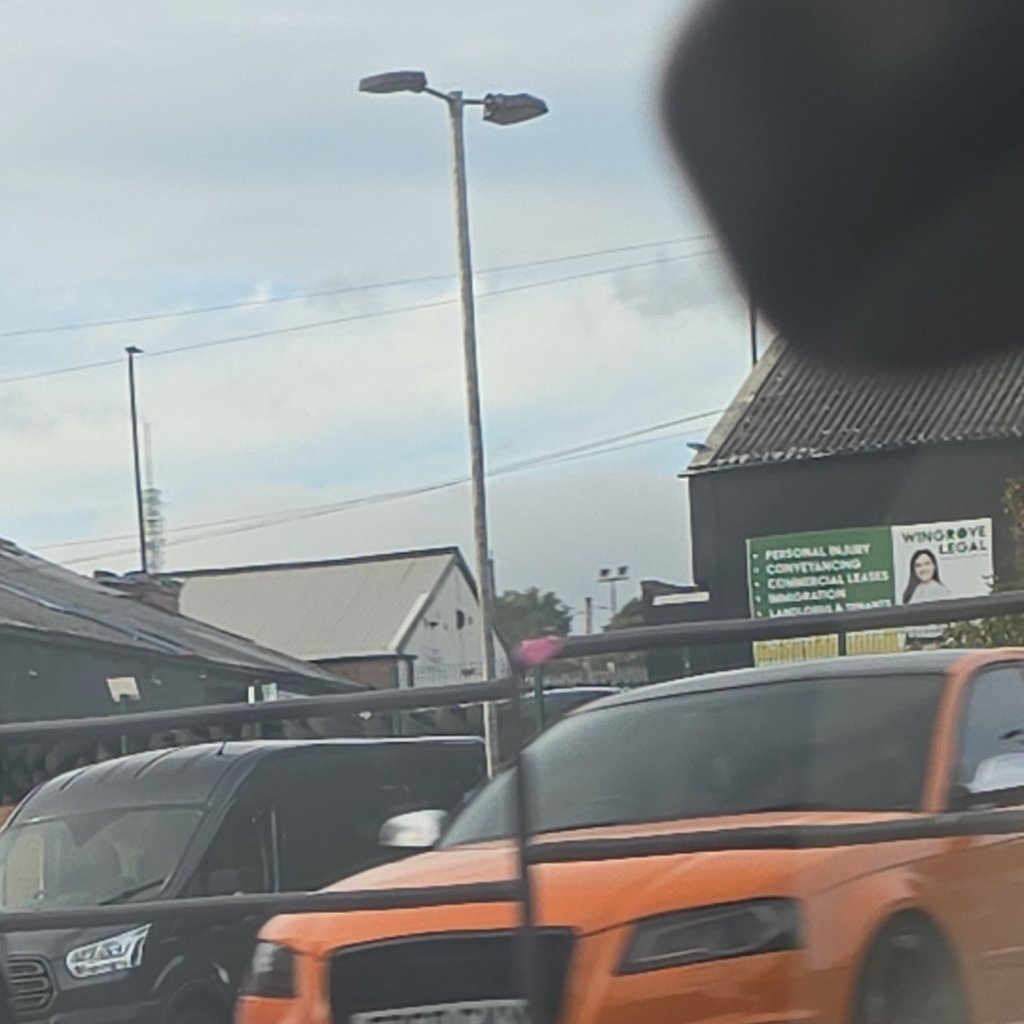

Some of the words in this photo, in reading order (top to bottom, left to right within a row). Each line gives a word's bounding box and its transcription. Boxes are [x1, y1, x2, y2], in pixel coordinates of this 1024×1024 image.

[902, 526, 986, 543] WINGROVE
[764, 547, 827, 561] PERSONAL
[938, 541, 987, 555] LEGAL
